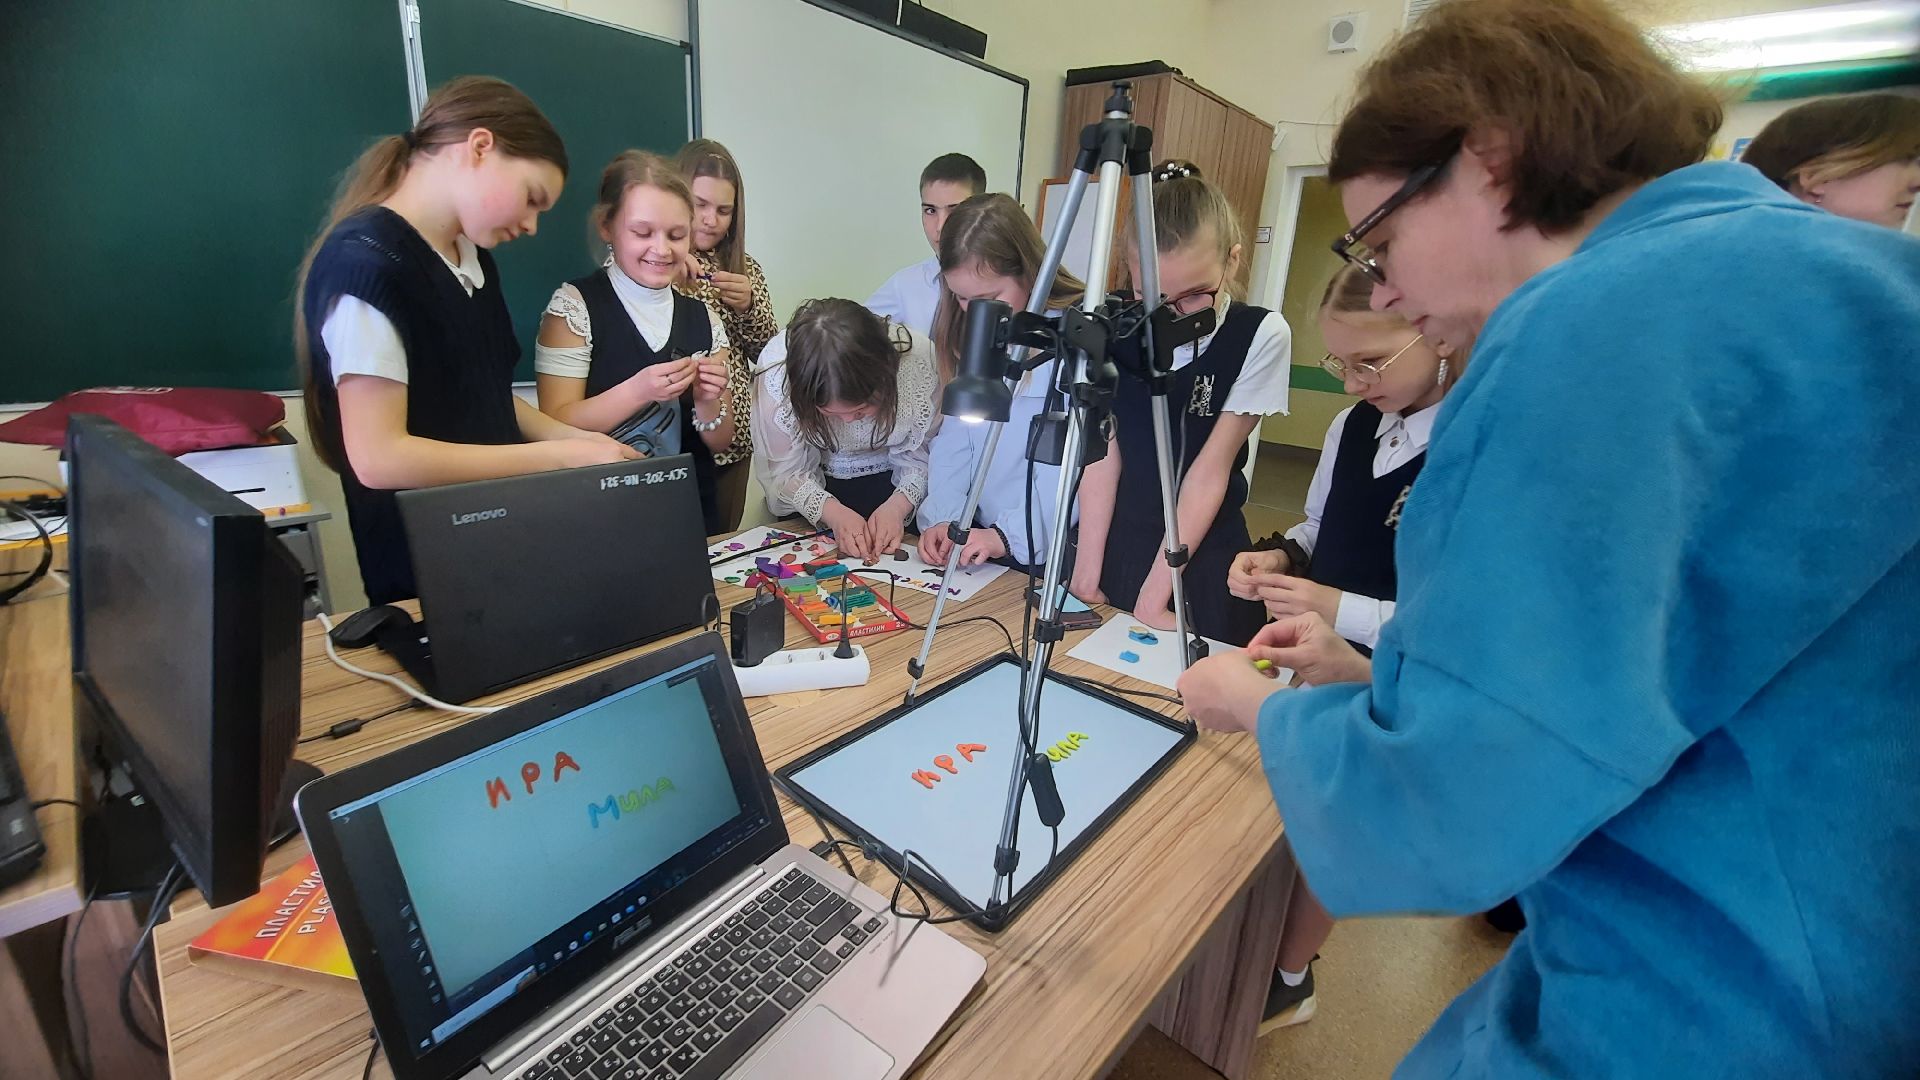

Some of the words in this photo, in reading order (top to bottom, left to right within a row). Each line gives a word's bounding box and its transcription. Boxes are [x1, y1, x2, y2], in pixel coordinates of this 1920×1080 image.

[452, 507, 507, 526] Lenovo
[850, 624, 886, 637] ПЛАСТИЛИН
[486, 751, 580, 809] ИРА
[911, 743, 987, 790] ИРА
